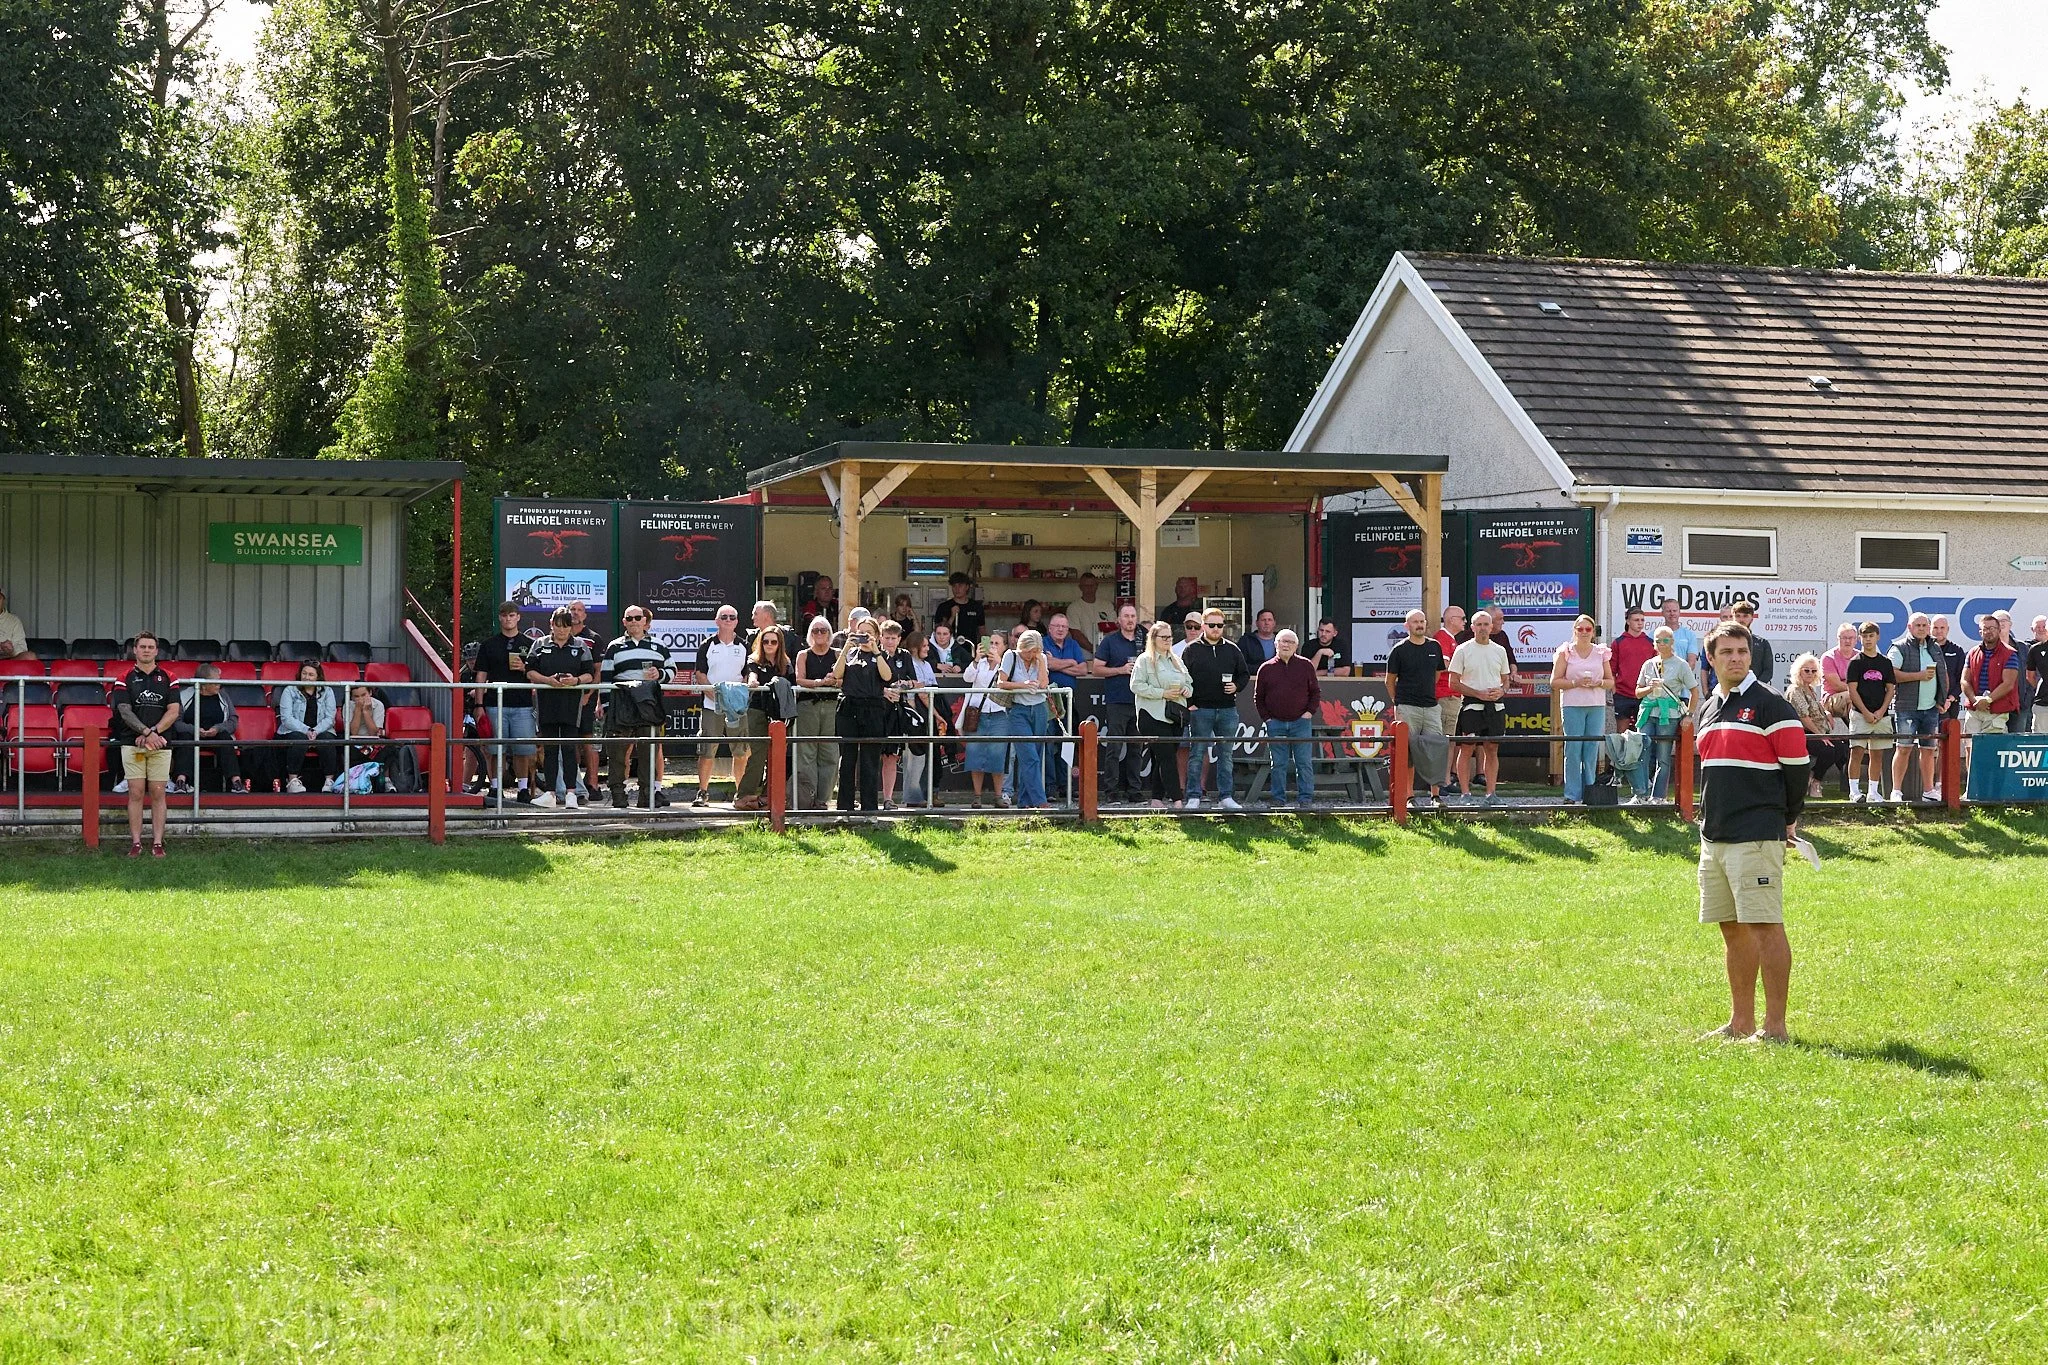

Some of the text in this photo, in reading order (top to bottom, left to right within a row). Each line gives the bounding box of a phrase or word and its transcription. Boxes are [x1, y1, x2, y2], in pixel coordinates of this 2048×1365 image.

[507, 515, 606, 526] FELINFOEL BREWERY
[640, 520, 734, 530] FELINFOEL BREWERY
[1355, 533, 1406, 542] FELINFOEL
[1480, 528, 1580, 538] FELINFOEL BREWERY
[234, 532, 338, 548] SWANSEA
[537, 583, 549, 595] C.T
[551, 584, 575, 595] LEWIS
[577, 584, 591, 595] LTD
[646, 588, 726, 598] JJ CAR SALES
[1493, 582, 1563, 595] BEECHWOOD
[1765, 587, 1818, 596] Car/Van MOTs
[1493, 594, 1563, 606] COMMERCIALS
[1677, 585, 1760, 611] Davies
[1783, 597, 1817, 606] Servicing
[1686, 620, 1714, 632] South
[1765, 624, 1818, 632] 01792 795 705
